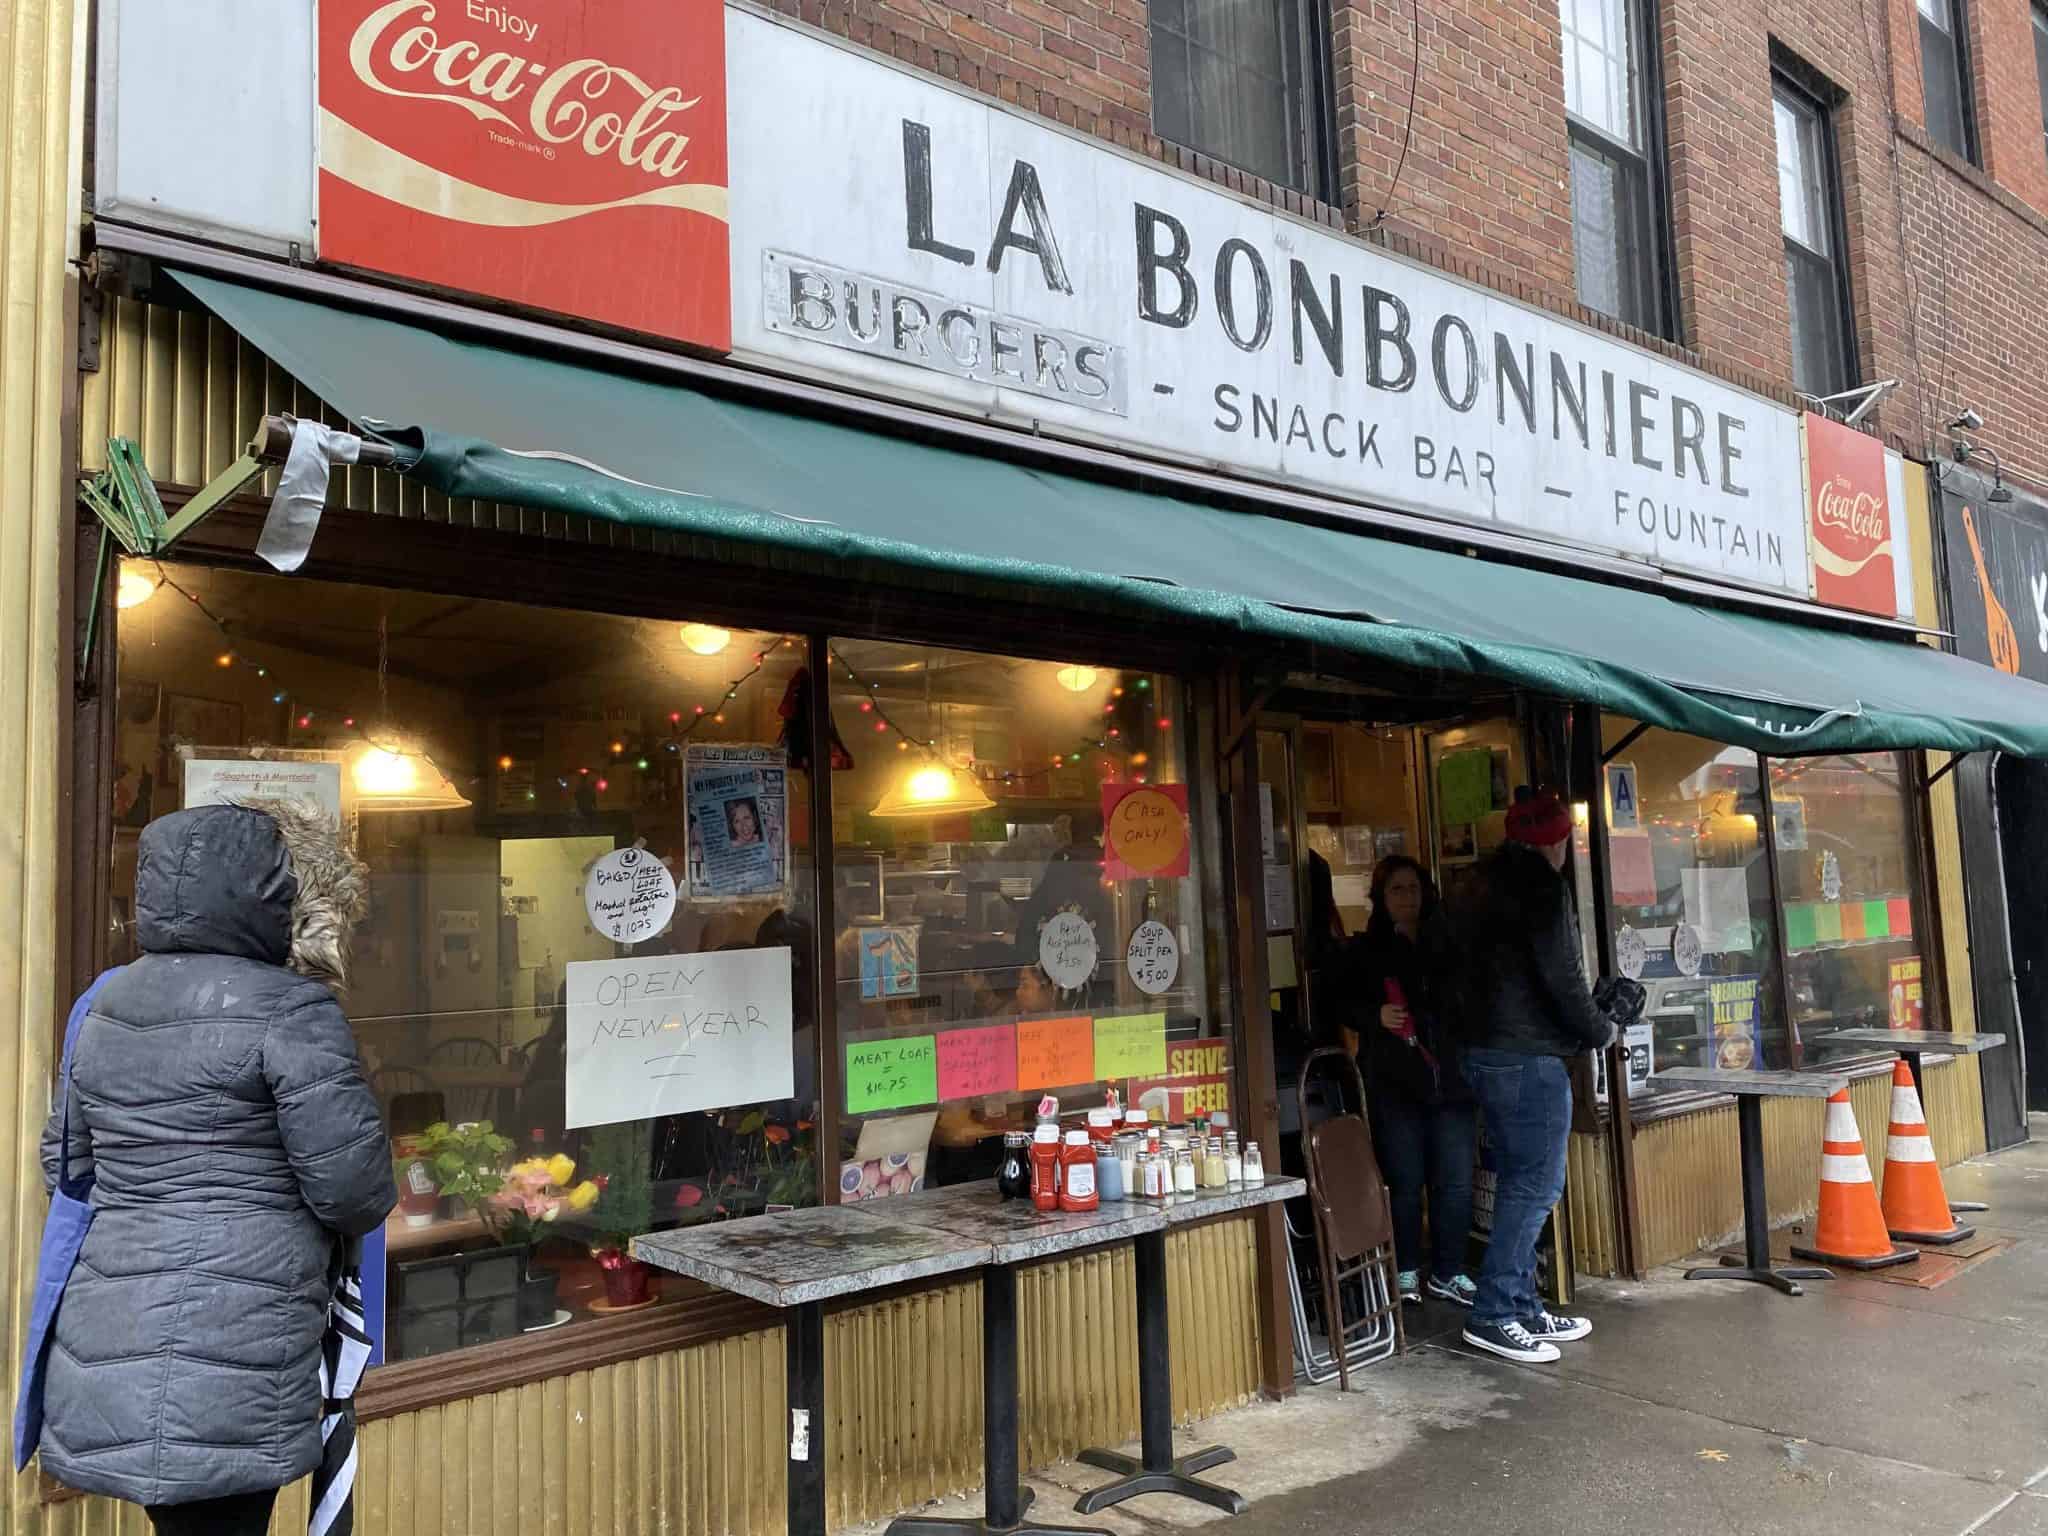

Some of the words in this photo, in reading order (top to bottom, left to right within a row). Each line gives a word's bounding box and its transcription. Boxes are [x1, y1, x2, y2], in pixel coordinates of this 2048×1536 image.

[465, 0, 538, 41] Enjoy
[349, 0, 702, 178] Coca-Cola
[902, 118, 1074, 296] LA
[1134, 202, 1750, 498] BONBONNIERE
[788, 267, 1110, 398] BURGERS
[1213, 383, 1384, 469] SNACK
[1414, 436, 1497, 498] BAR
[1613, 490, 1782, 568] FOUNTAIN
[1817, 481, 1883, 540] Coca-Cola
[1615, 772, 1632, 810] A
[1140, 926, 1164, 941] SOUP
[597, 967, 704, 1009] OPEN
[593, 1014, 667, 1046] NEW
[679, 1005, 769, 1042] YEAR
[853, 1050, 890, 1066] MEAT
[899, 1047, 931, 1062] LOAF
[1171, 1046, 1227, 1077] SERVE
[1184, 1082, 1228, 1114] BEER
